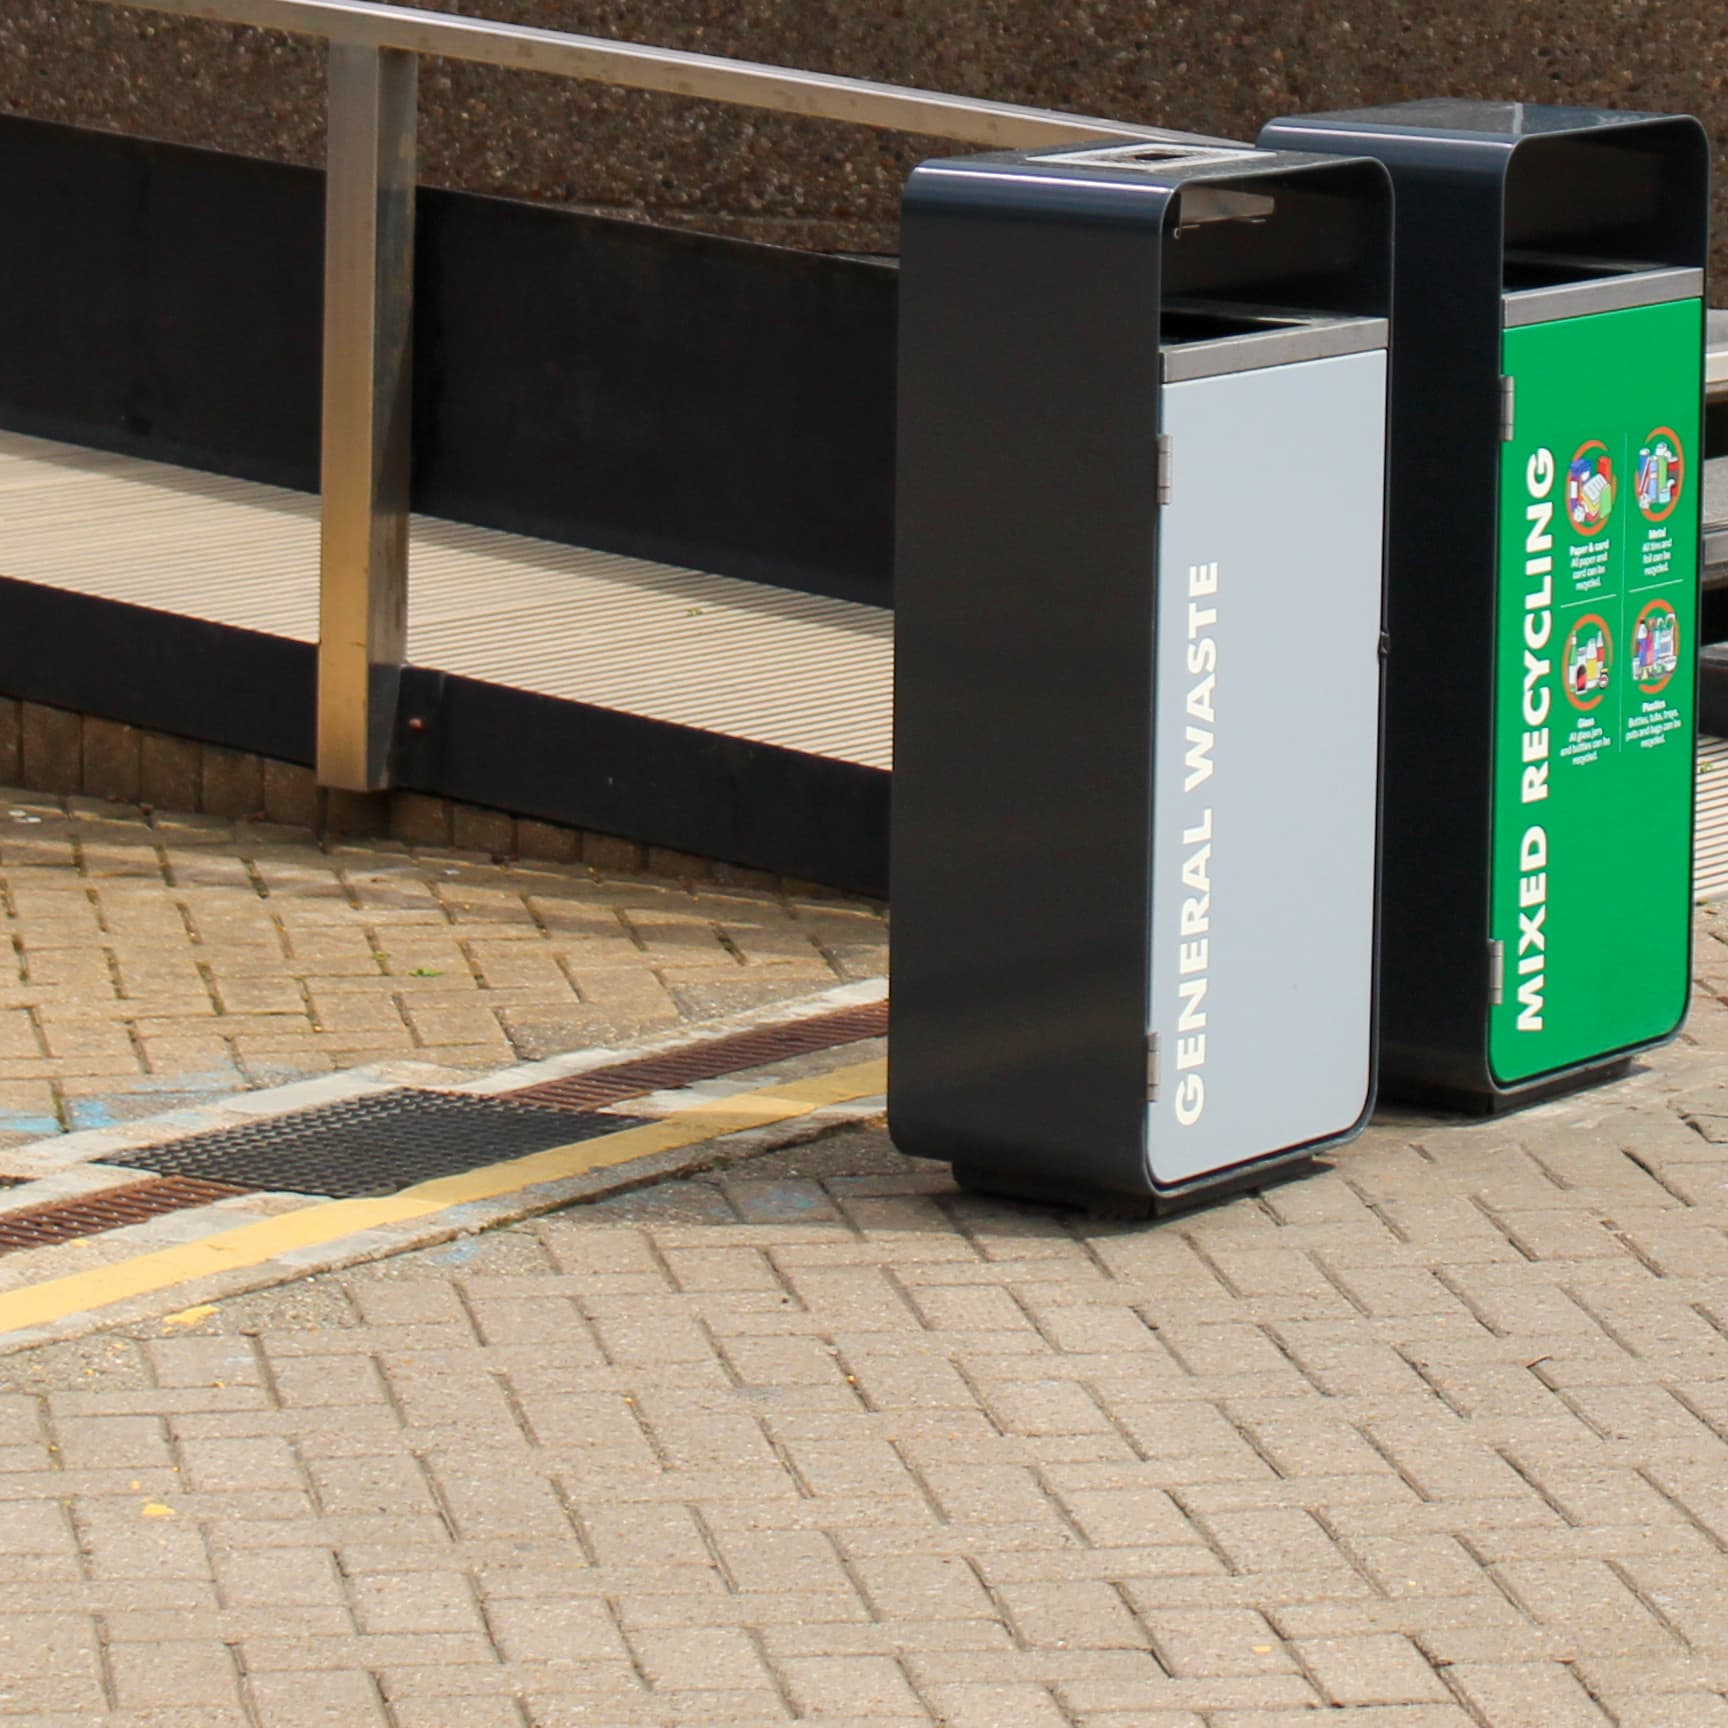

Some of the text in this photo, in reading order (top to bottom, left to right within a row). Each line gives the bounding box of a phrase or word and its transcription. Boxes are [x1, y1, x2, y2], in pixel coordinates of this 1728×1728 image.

[1569, 538, 1610, 557] Paper & card
[1648, 526, 1667, 540] Metal
[1175, 562, 1218, 1126] GENERAL WASTE
[1517, 448, 1555, 1032] MIXED RECYCLING
